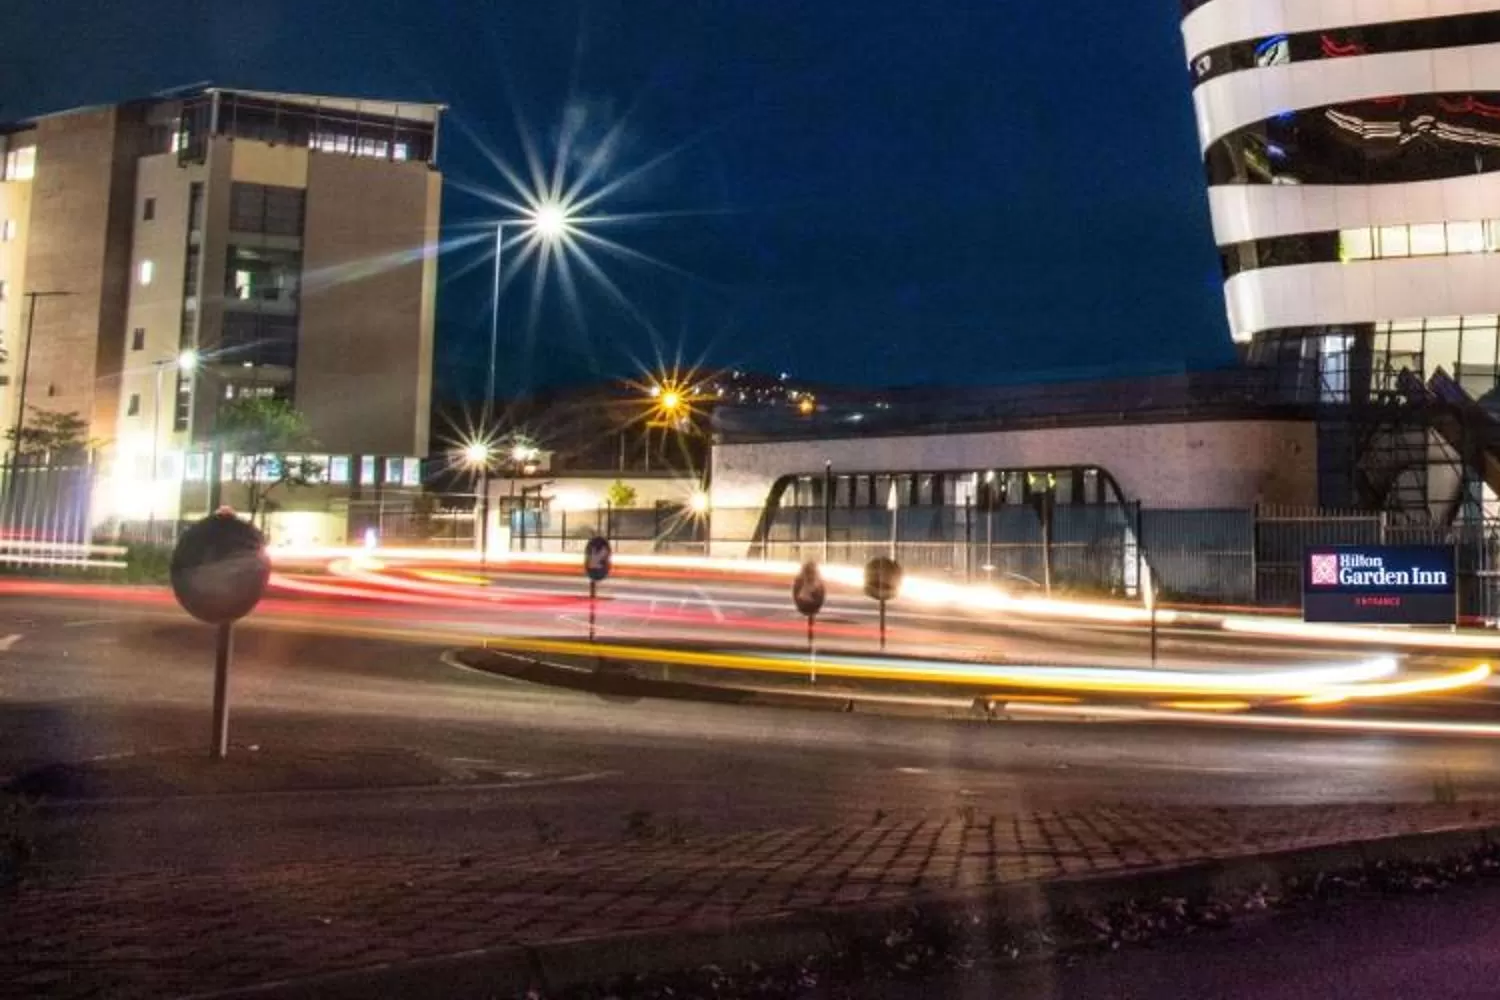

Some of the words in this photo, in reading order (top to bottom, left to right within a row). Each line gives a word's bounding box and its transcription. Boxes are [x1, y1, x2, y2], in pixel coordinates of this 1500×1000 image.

[1340, 554, 1383, 567] Hilton
[1340, 568, 1408, 585] Garden
[1411, 567, 1447, 585] Inn
